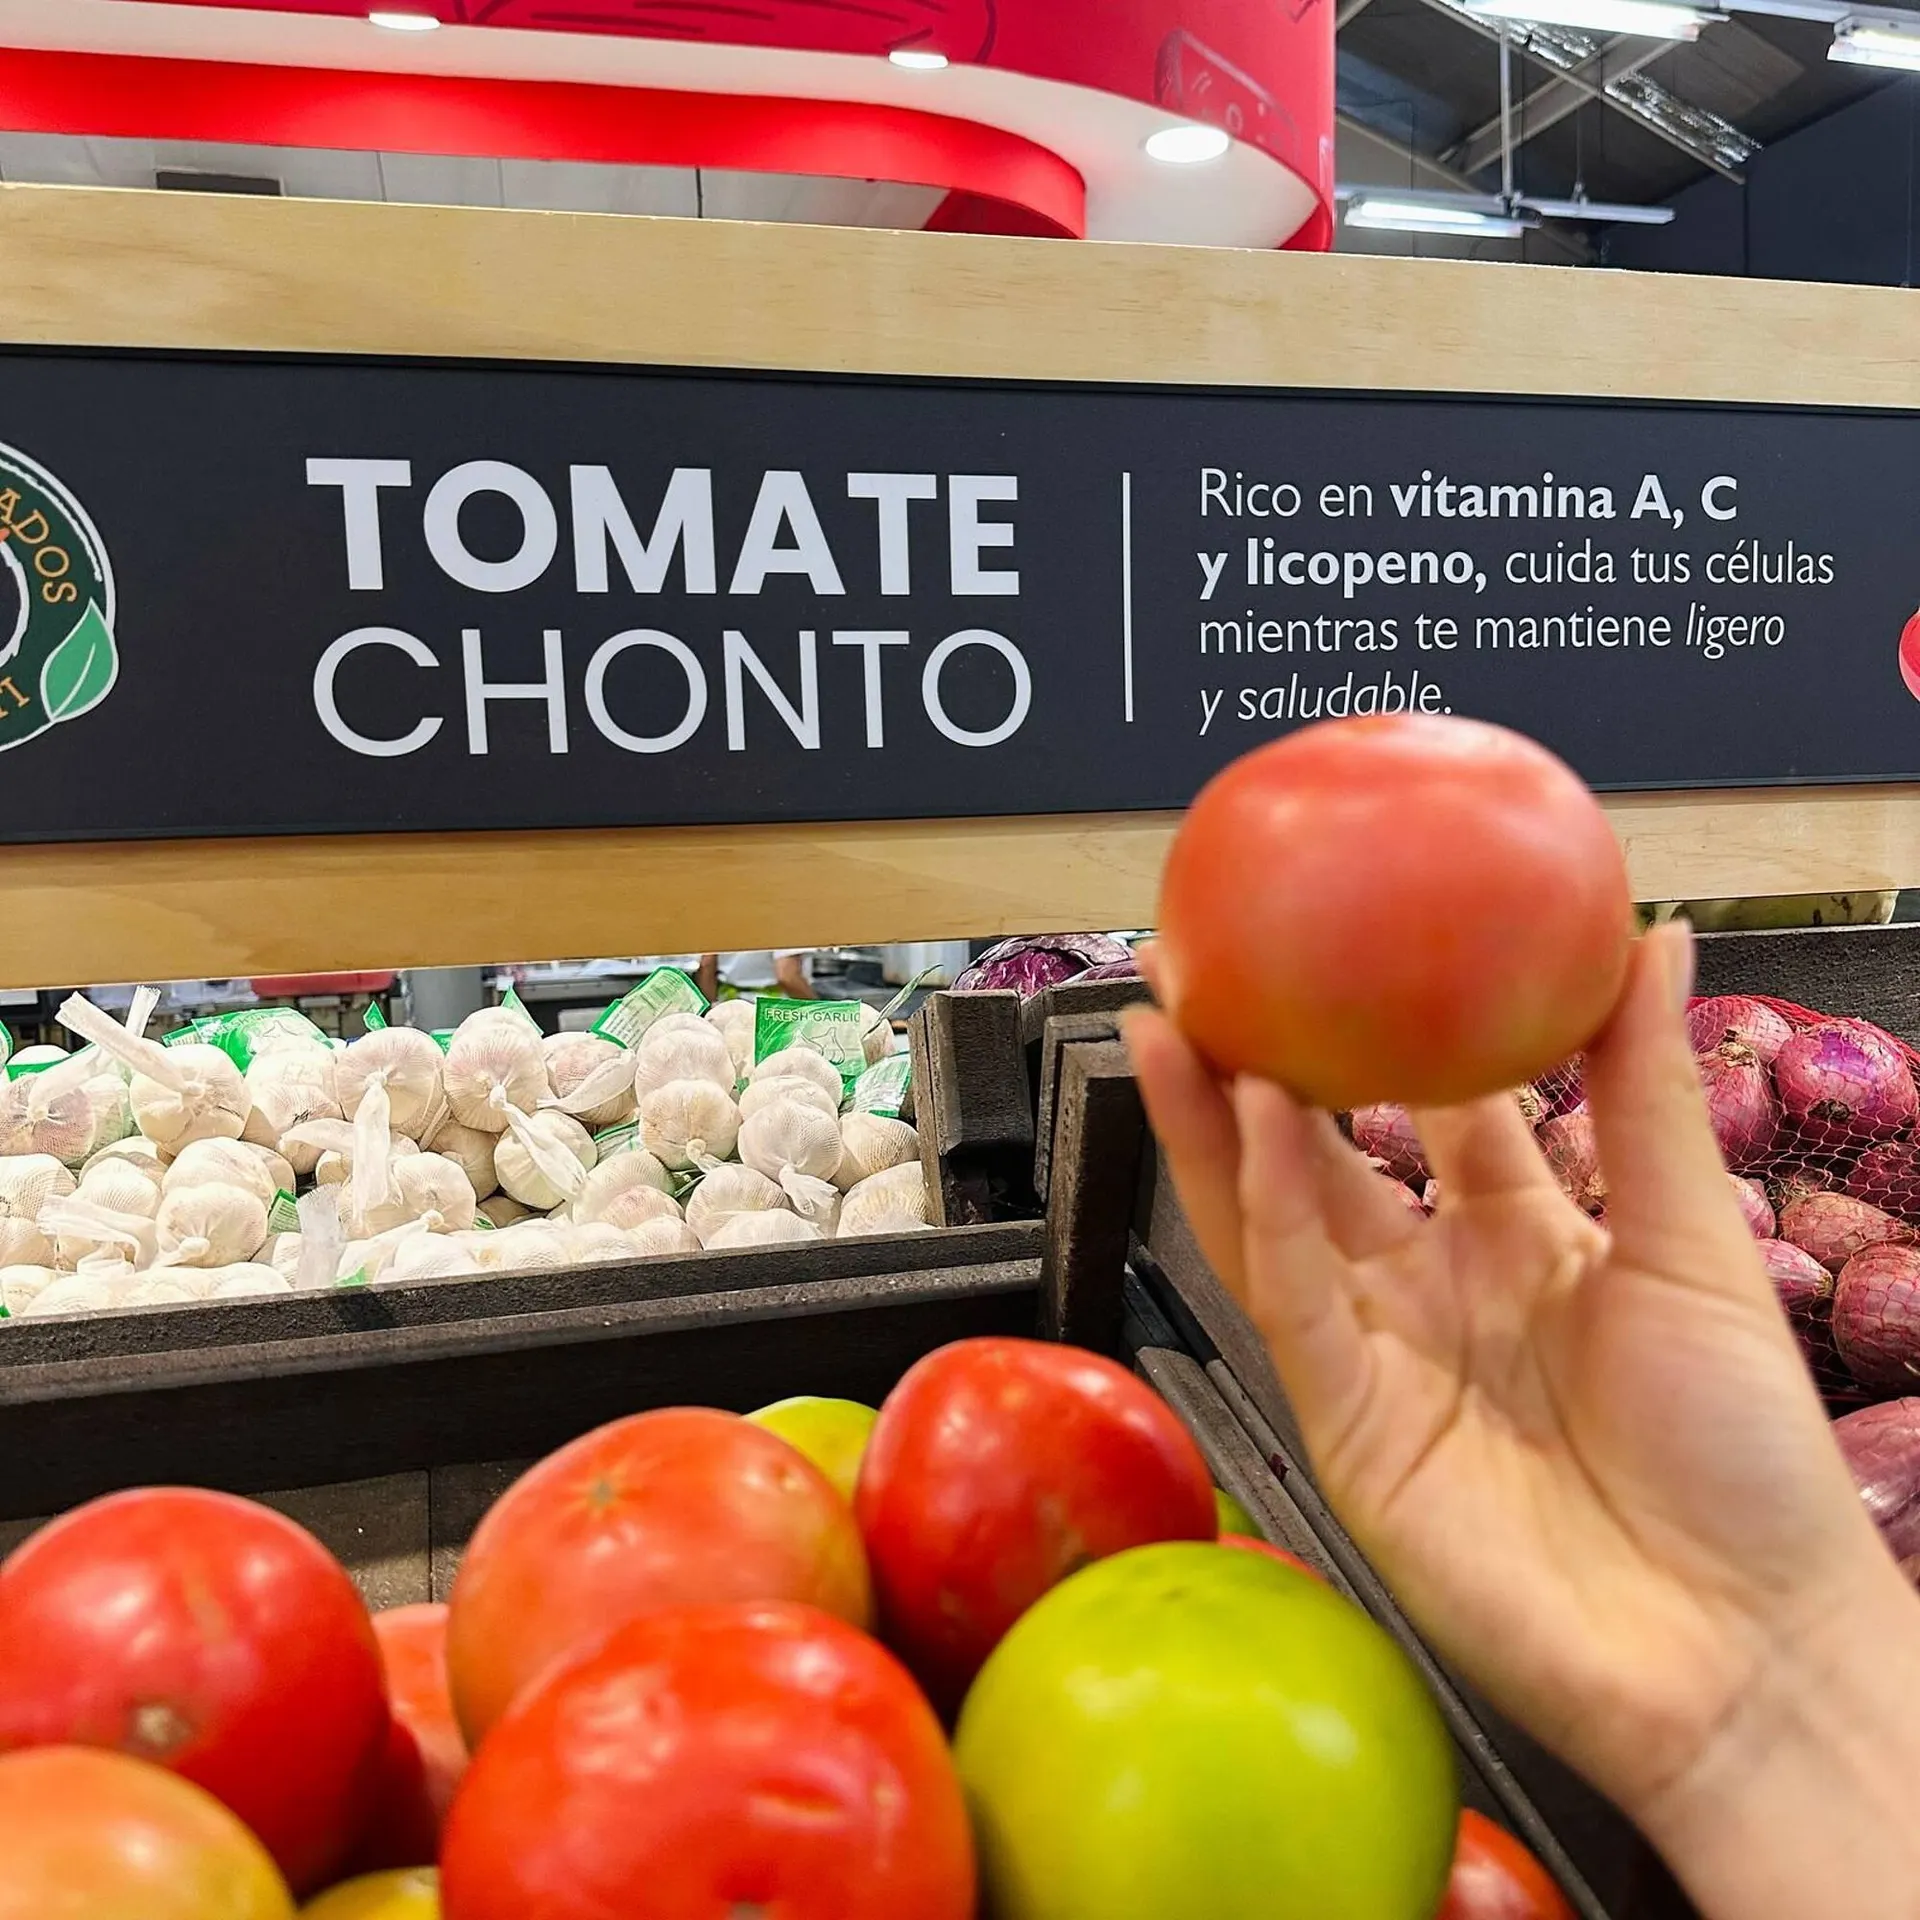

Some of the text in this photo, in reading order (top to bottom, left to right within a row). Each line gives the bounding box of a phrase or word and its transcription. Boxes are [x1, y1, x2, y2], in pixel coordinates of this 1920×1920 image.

[306, 457, 1020, 596] TOMATE
[1201, 467, 1737, 530] Rico en vitamina A, C
[1196, 537, 1834, 600] y licopeno, cuida tus células
[1200, 602, 1785, 660] mientras te mantiene ligero
[313, 626, 1032, 756] CHONTO
[1199, 671, 1453, 736] y saludable.
[765, 1008, 809, 1022] FRESH
